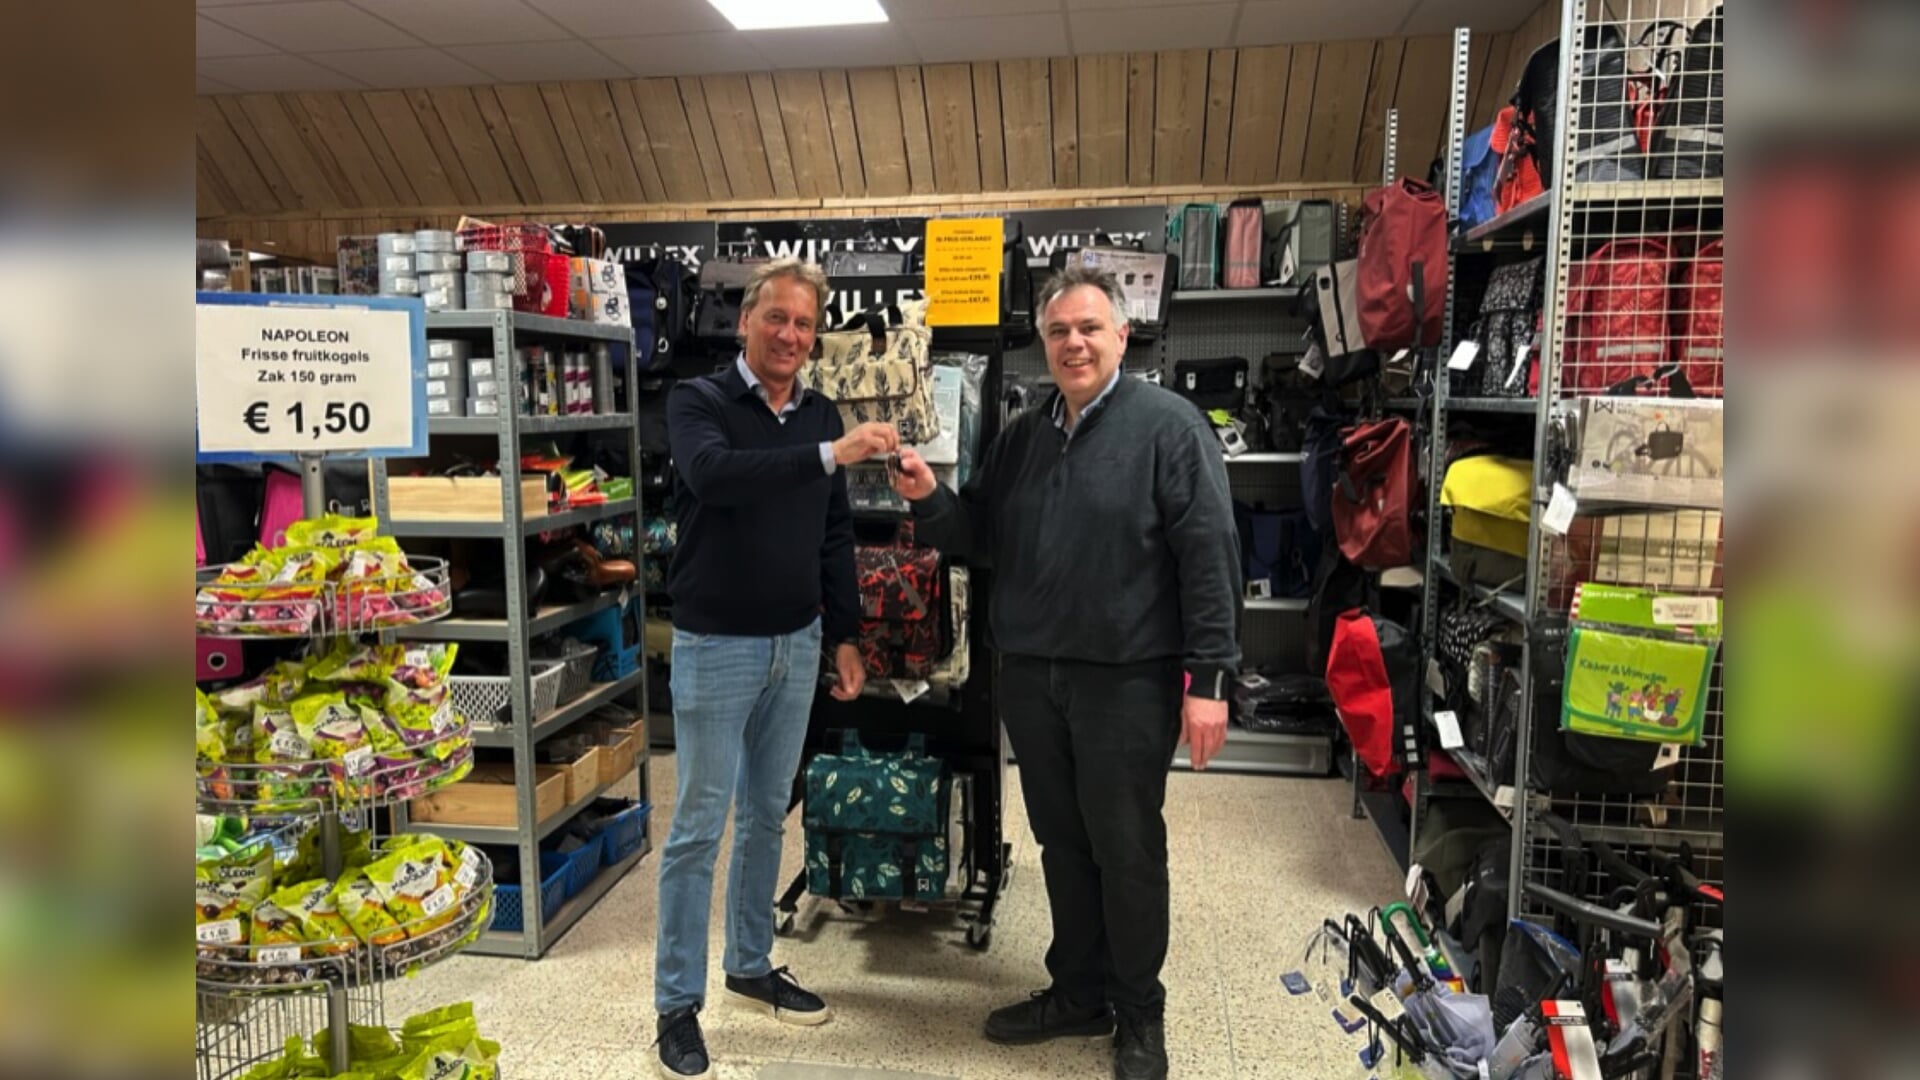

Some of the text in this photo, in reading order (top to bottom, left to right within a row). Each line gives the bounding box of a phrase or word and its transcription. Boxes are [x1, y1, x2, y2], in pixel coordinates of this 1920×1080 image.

[261, 329, 349, 343] NAPOLEON
[241, 348, 370, 365] Frisse fruitkogels
[258, 370, 357, 385] Zak 150 gram
[243, 401, 371, 439] € 1,50
